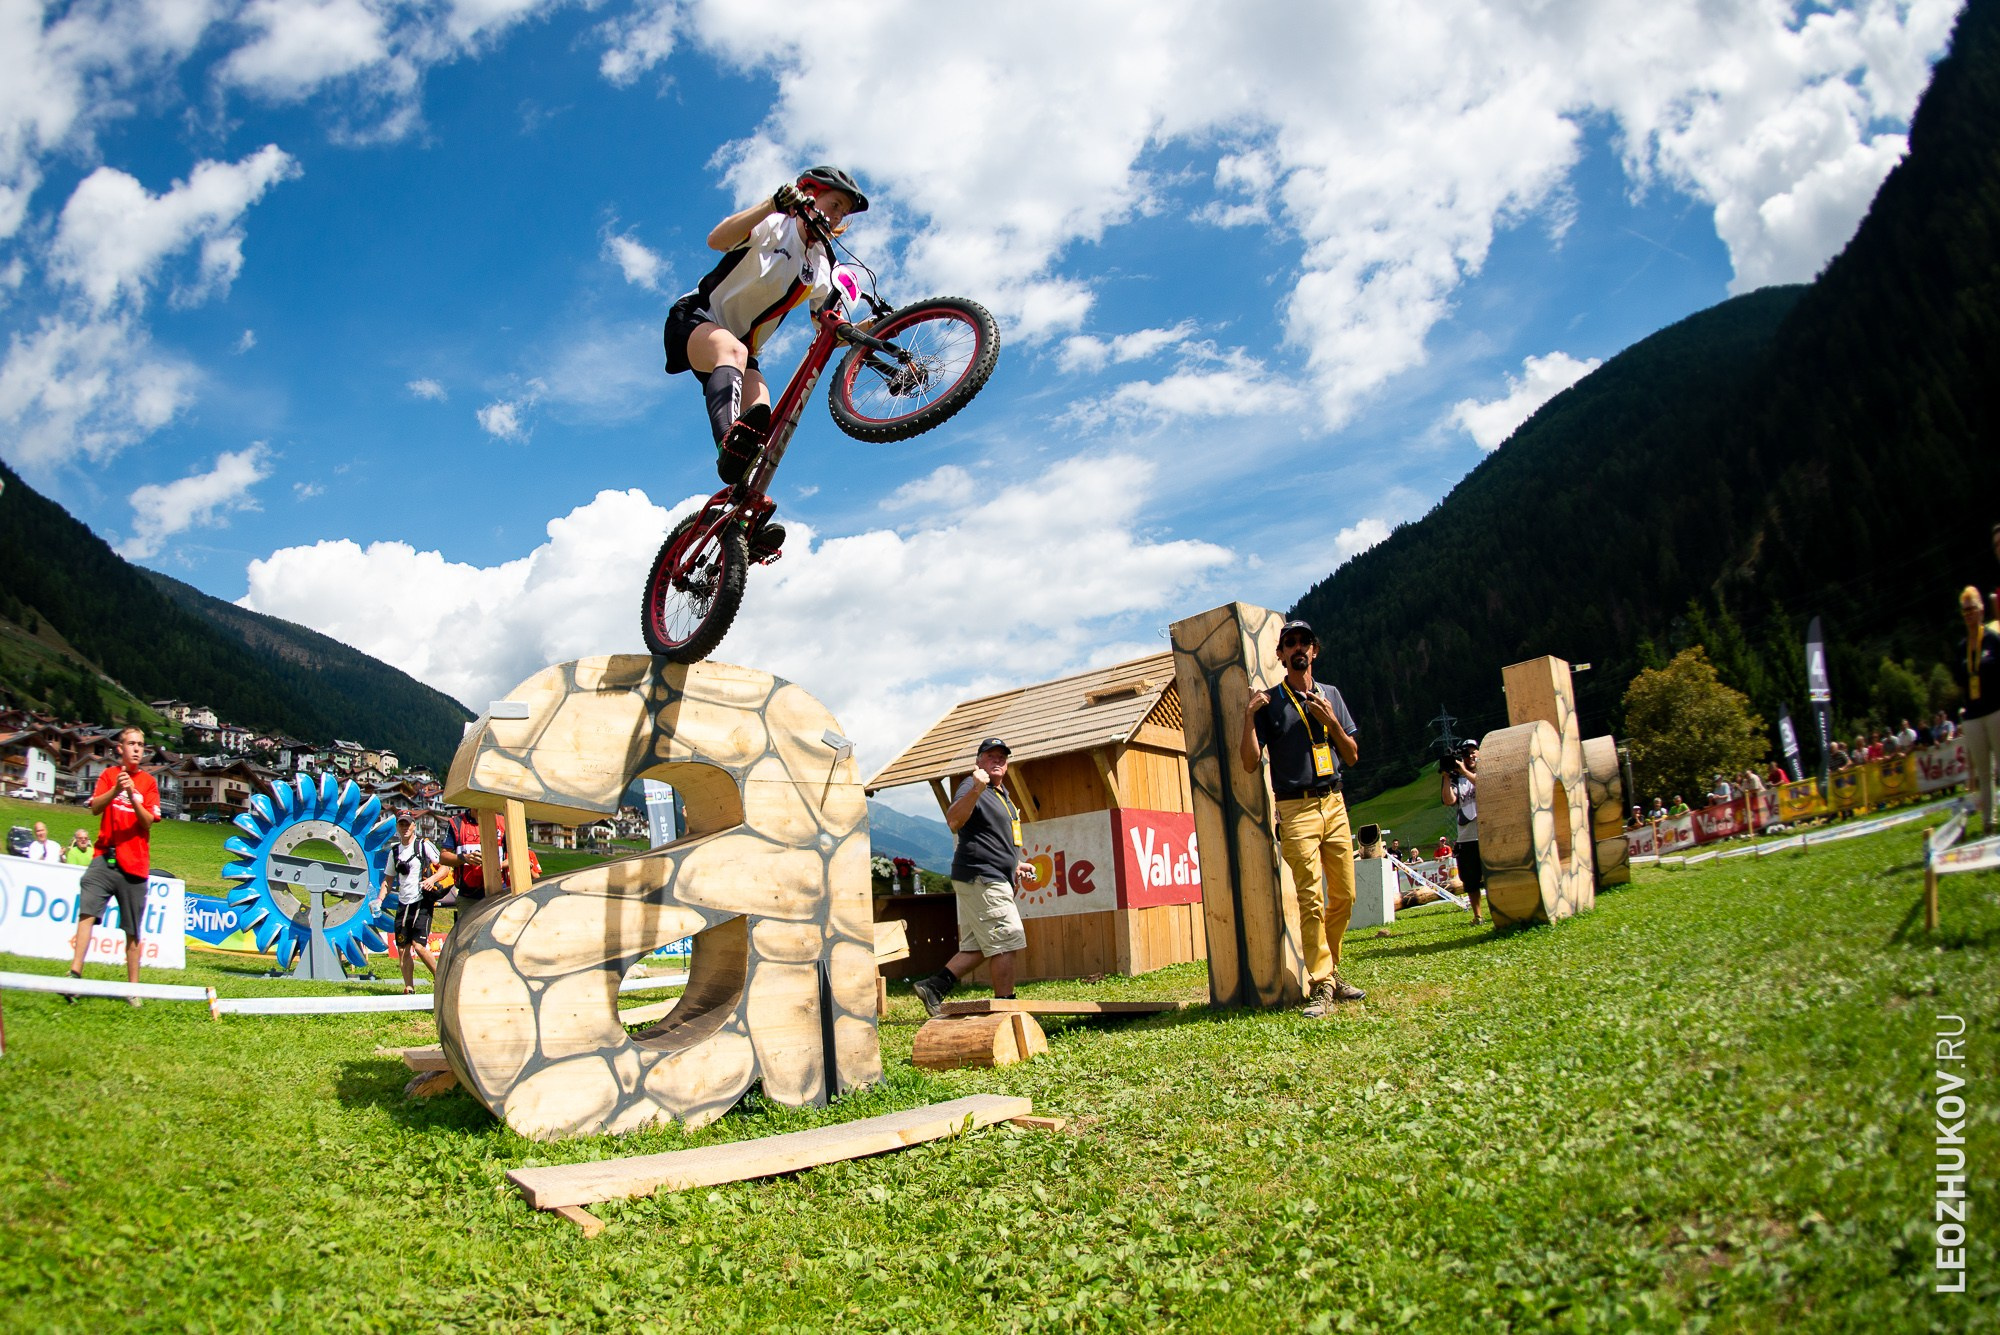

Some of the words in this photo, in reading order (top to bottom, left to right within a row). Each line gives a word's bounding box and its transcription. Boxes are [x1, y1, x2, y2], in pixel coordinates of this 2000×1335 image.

[1130, 826, 1172, 891] Val
[1173, 853, 1189, 886] di
[1187, 831, 1201, 885] S
[1629, 839, 1641, 856] al
[1014, 846, 1096, 900] ole
[184, 907, 238, 933] ENTINO
